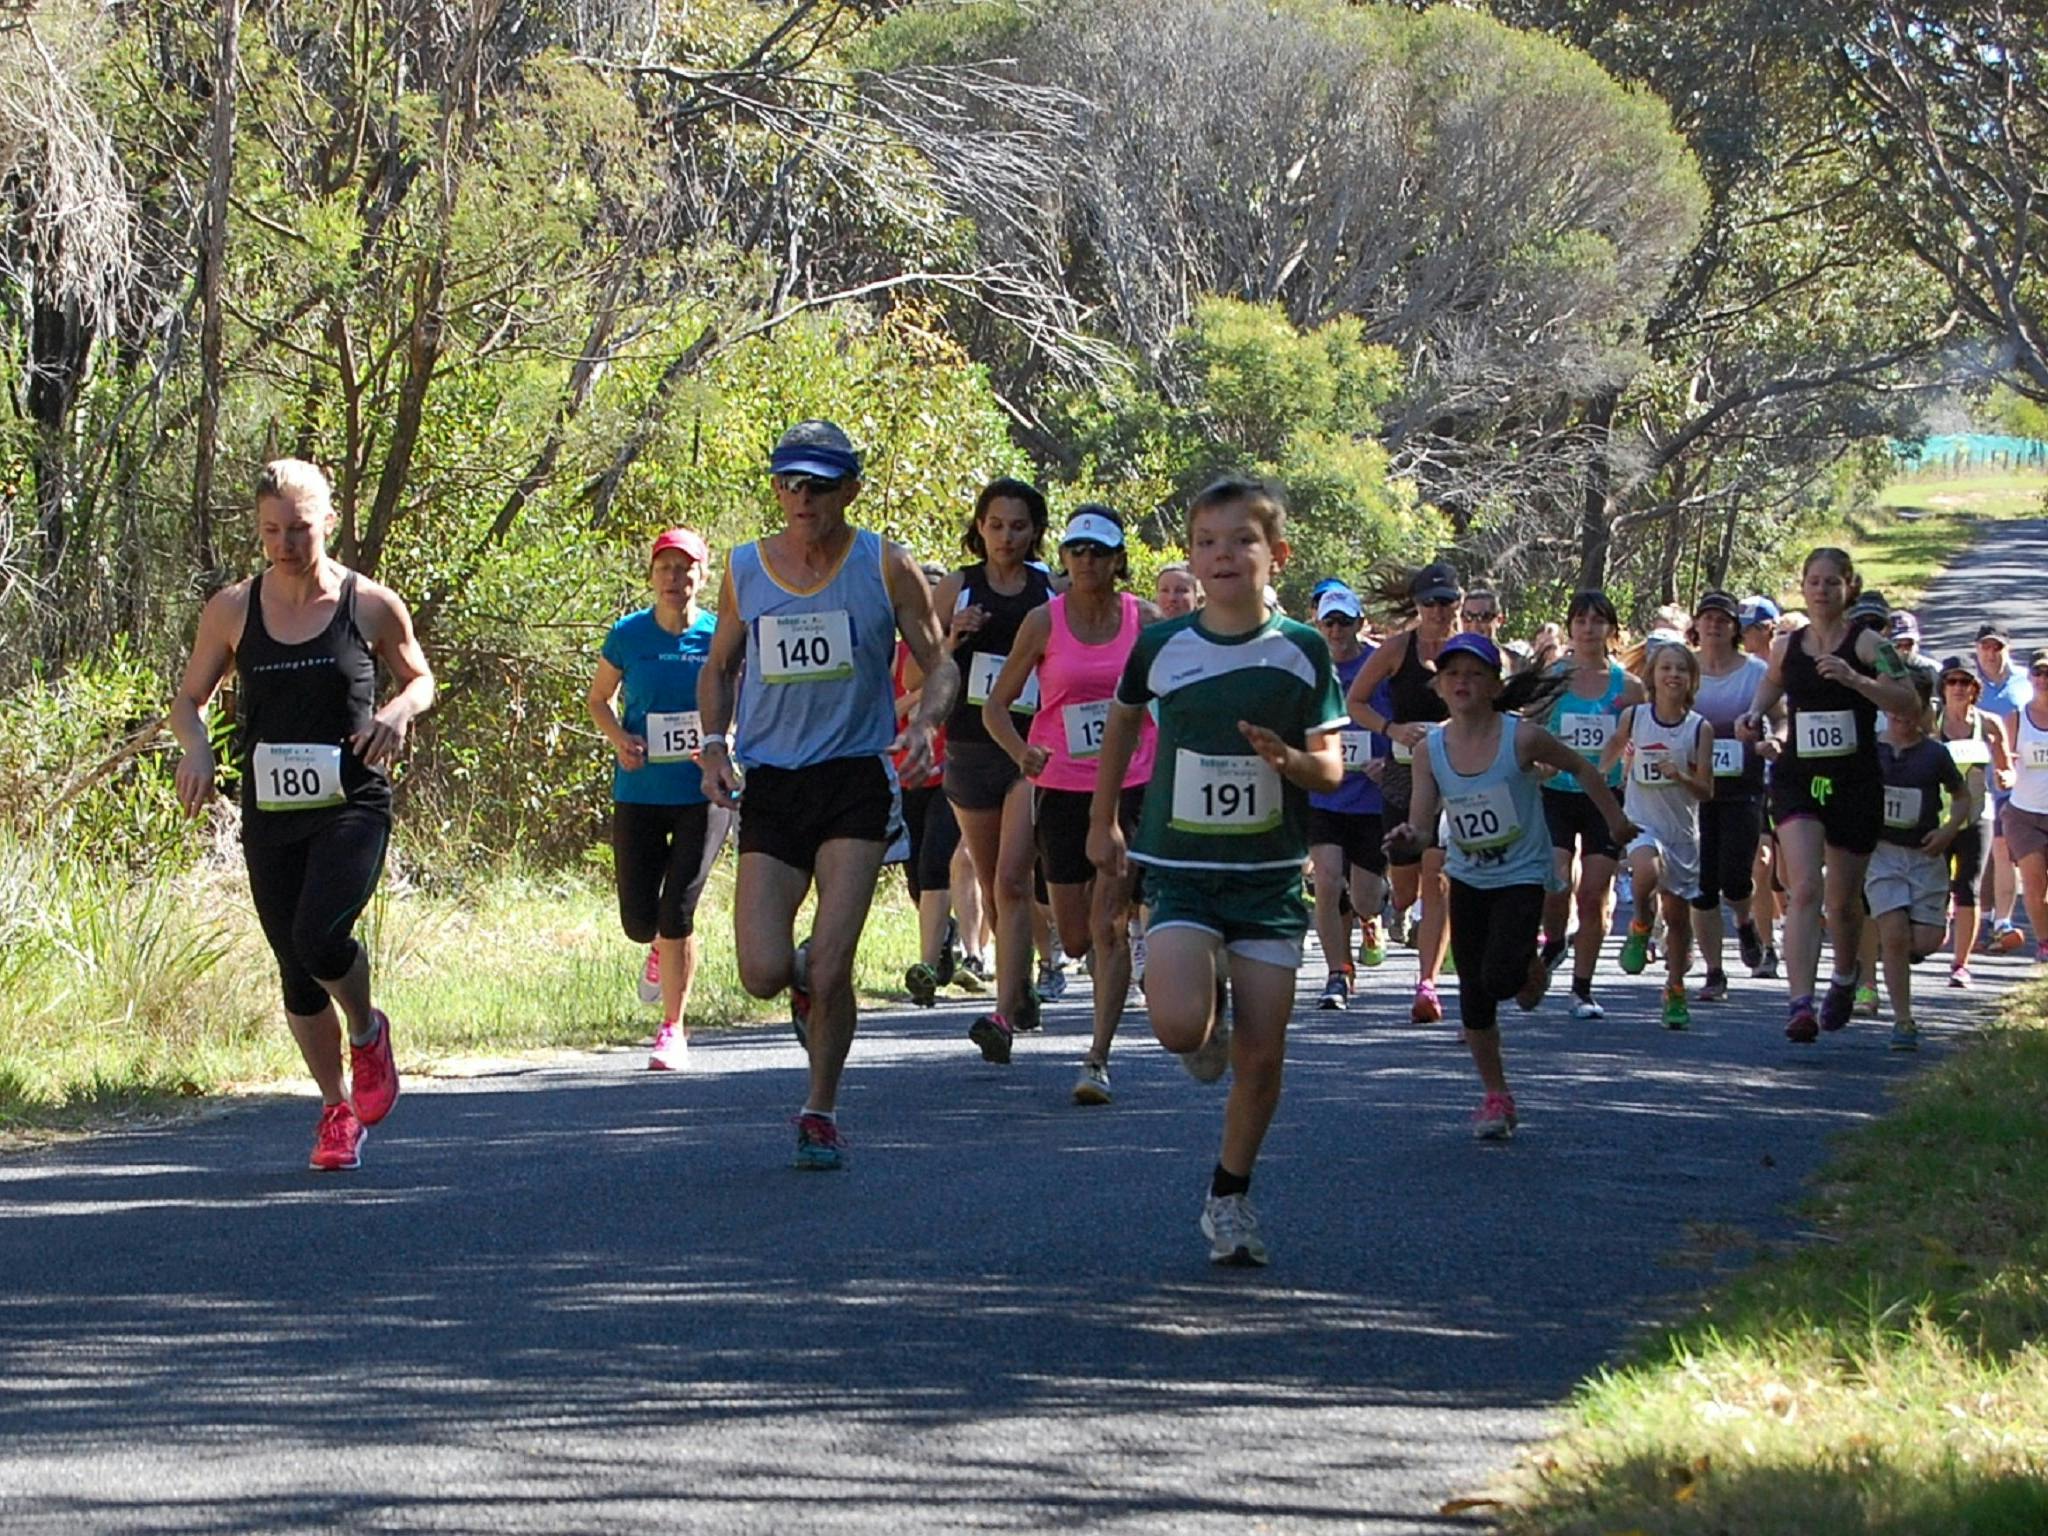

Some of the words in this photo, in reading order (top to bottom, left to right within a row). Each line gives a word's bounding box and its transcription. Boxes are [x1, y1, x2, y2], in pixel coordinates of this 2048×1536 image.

[776, 636, 830, 669] 140
[663, 728, 700, 752] 153
[1573, 727, 1604, 747] 139
[1808, 727, 1844, 748] 108
[270, 766, 321, 797] 180
[1200, 782, 1256, 816] 191
[1454, 808, 1500, 839] 120
